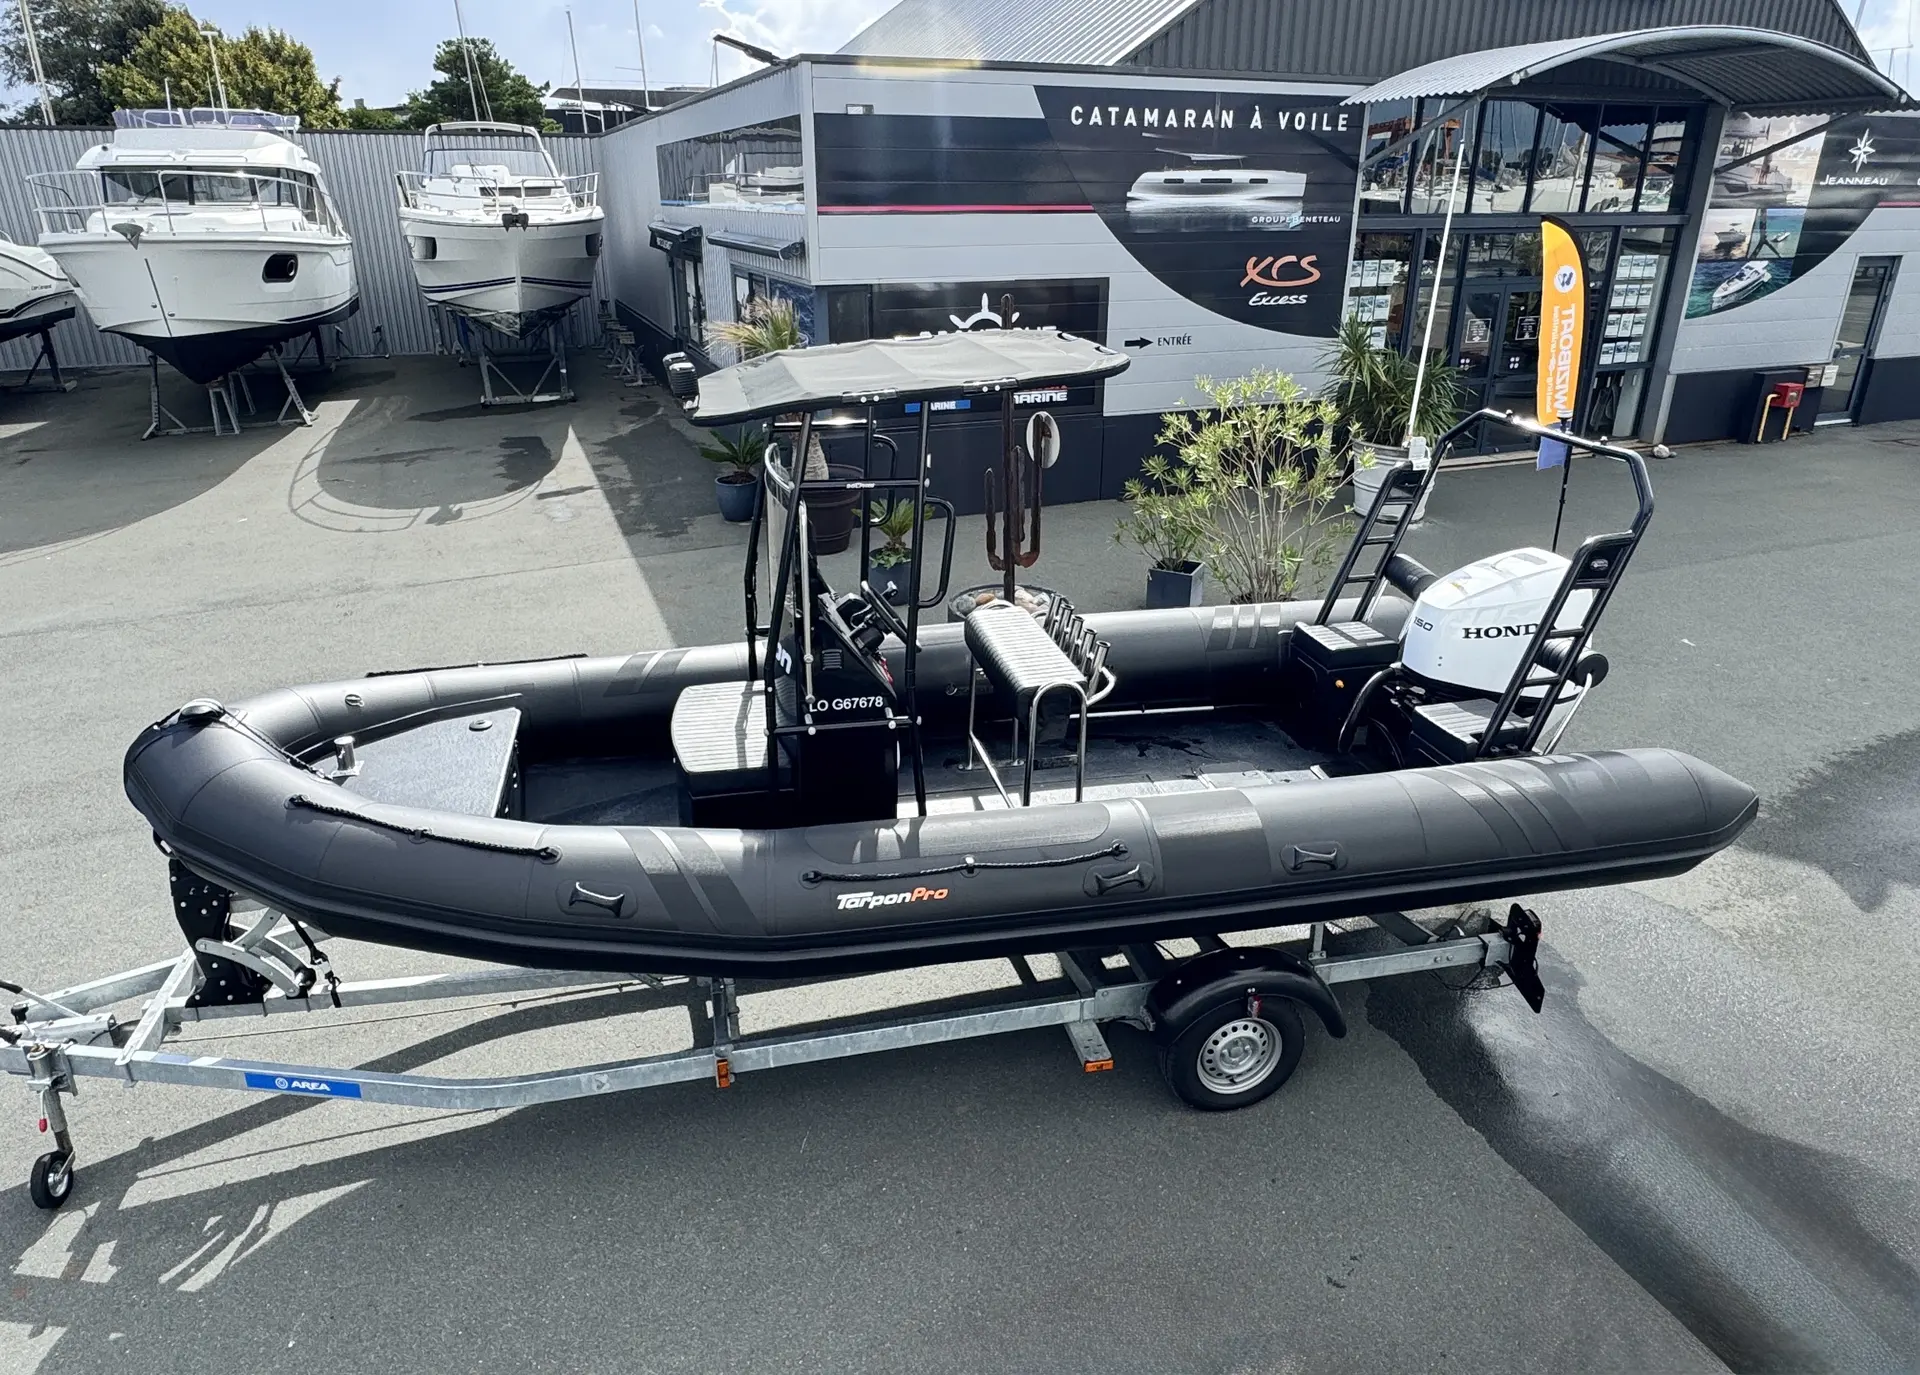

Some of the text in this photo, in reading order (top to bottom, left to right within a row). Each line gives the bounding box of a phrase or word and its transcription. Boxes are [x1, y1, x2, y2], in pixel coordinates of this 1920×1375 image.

[1070, 105, 1349, 132] CATAMARAN À VOILE
[1248, 291, 1308, 306] Excess
[1157, 334, 1193, 347] ENTRÉE
[1462, 623, 1540, 639] HOND
[832, 696, 883, 710] G67678
[291, 1080, 331, 1091] AREA
